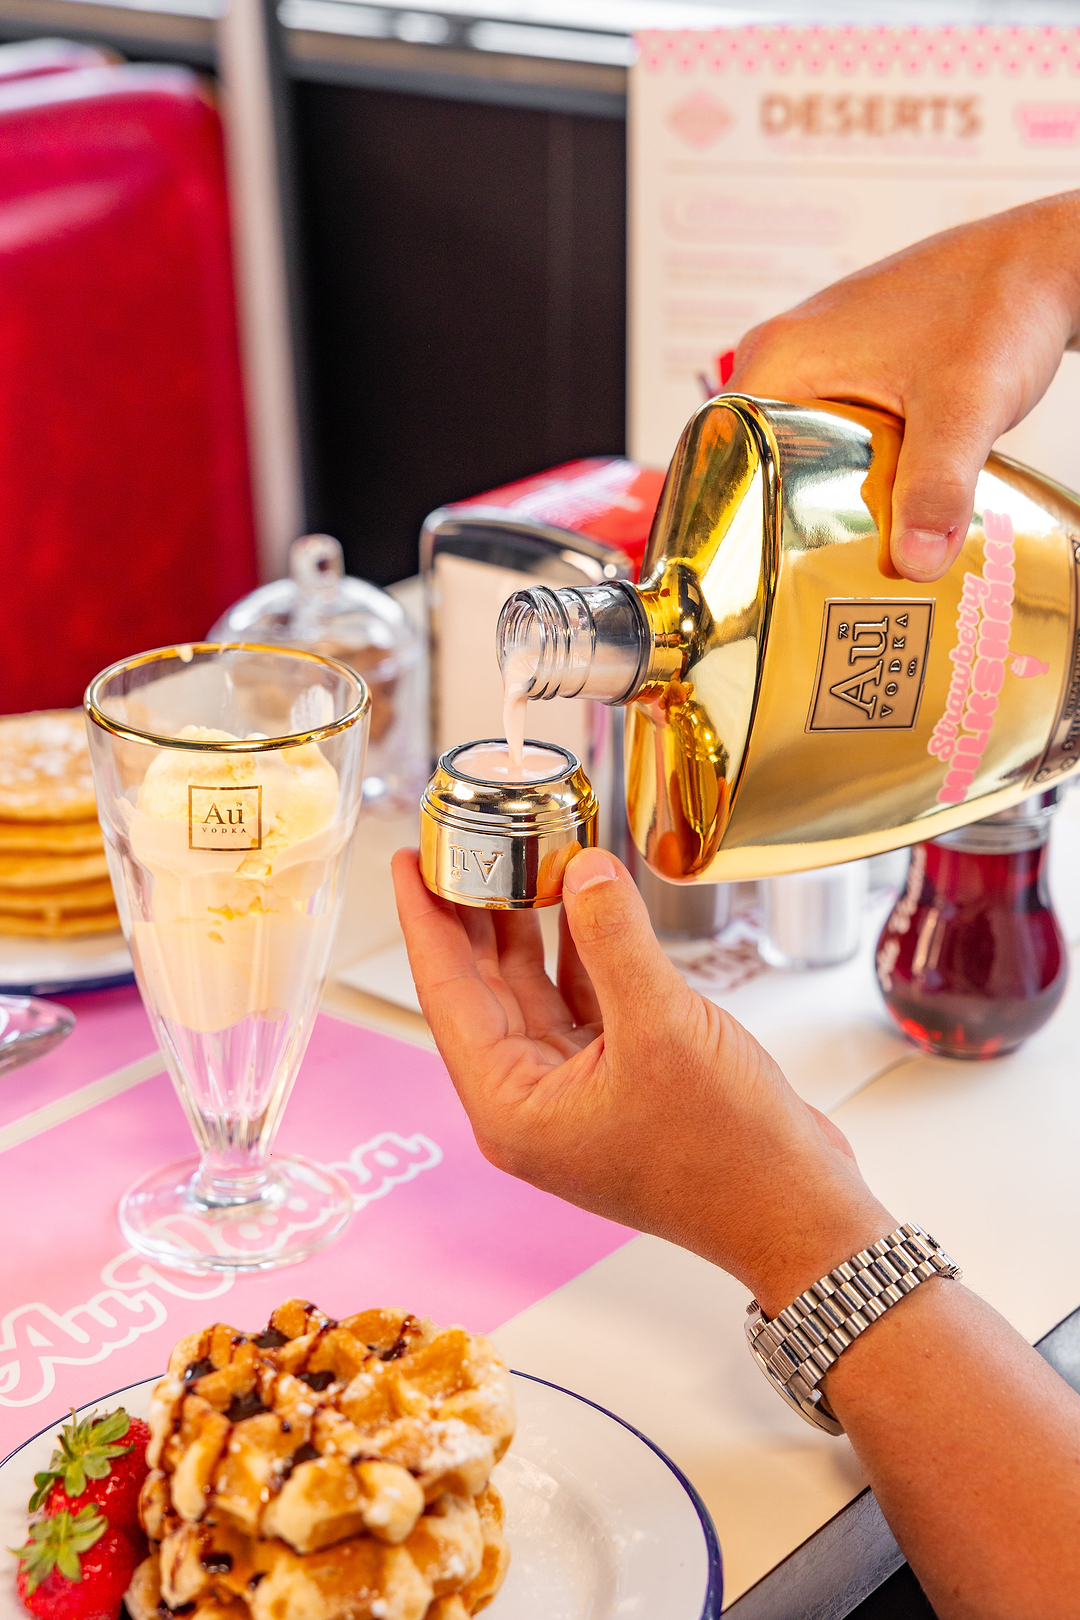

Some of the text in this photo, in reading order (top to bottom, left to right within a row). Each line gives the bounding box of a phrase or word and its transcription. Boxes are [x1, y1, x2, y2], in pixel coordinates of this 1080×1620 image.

[759, 93, 984, 138] DESERTS
[829, 615, 889, 719] Au
[838, 622, 849, 640] 79
[879, 613, 909, 718] VODKA
[928, 572, 990, 761] Strawberry
[936, 509, 1015, 804] MILKSHAKE
[202, 802, 245, 825] Au
[450, 845, 504, 884] Au
